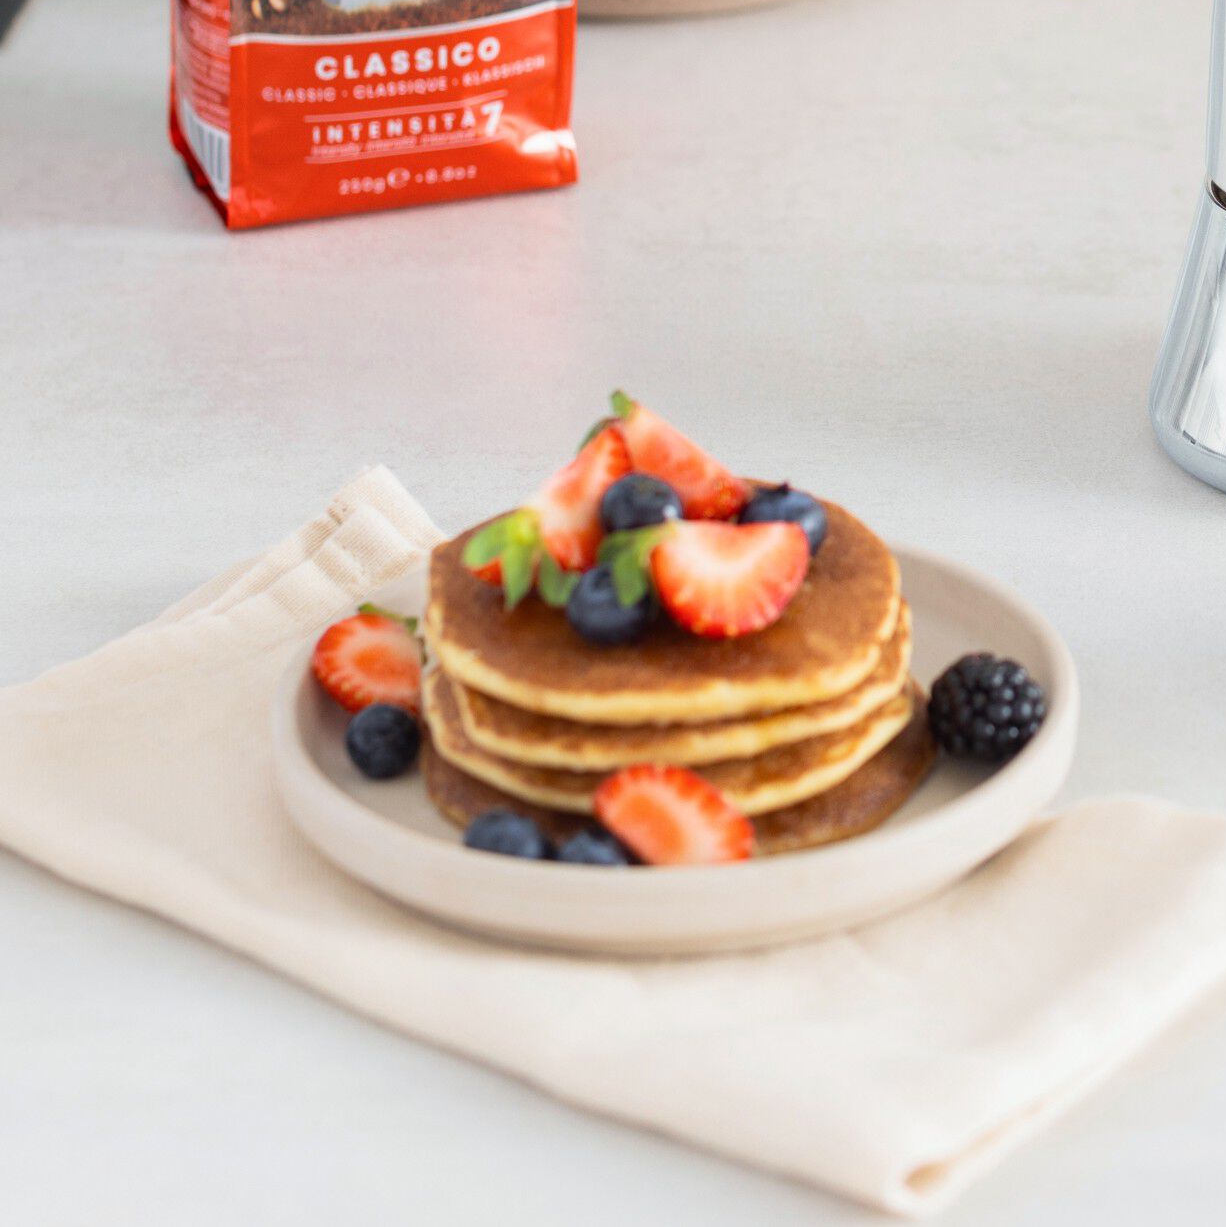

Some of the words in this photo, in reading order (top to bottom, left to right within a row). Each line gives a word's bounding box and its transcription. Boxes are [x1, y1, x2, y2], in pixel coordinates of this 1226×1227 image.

[313, 36, 501, 81] CLASSICO
[261, 86, 337, 103] CLASSIC
[352, 75, 448, 100] CLASSIQUE
[480, 100, 504, 138] 7
